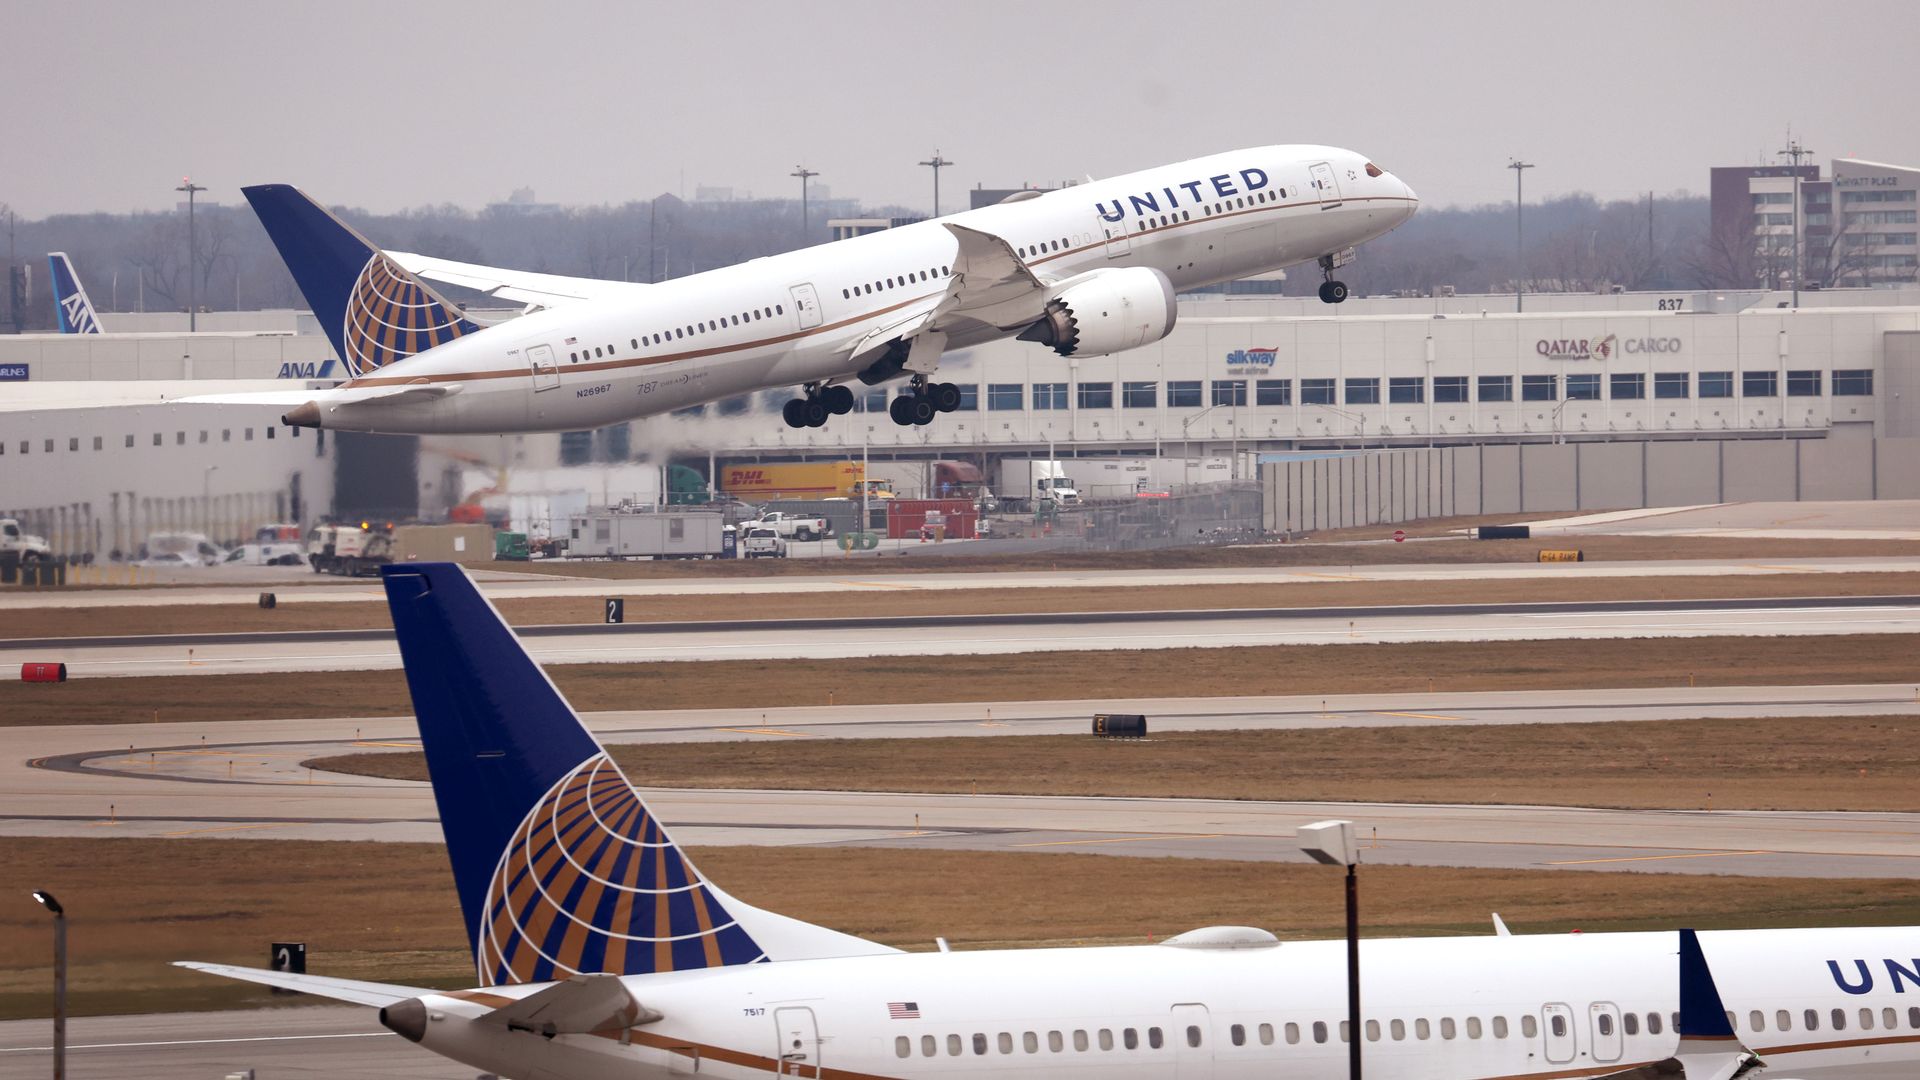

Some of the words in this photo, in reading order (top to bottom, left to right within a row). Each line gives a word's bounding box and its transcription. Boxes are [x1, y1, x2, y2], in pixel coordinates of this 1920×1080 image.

[1096, 168, 1268, 222] UNITED
[1658, 298, 1684, 311] 837
[1536, 339, 1589, 356] QATAR
[1624, 338, 1682, 354] CARGO
[1227, 350, 1277, 367] silkway
[277, 362, 316, 378] ANA
[576, 383, 611, 398] N26967
[637, 381, 658, 395] 787
[729, 471, 772, 485] DHL
[609, 600, 616, 623] 2
[1826, 958, 1920, 995] UN
[743, 1008, 765, 1017] 7517
